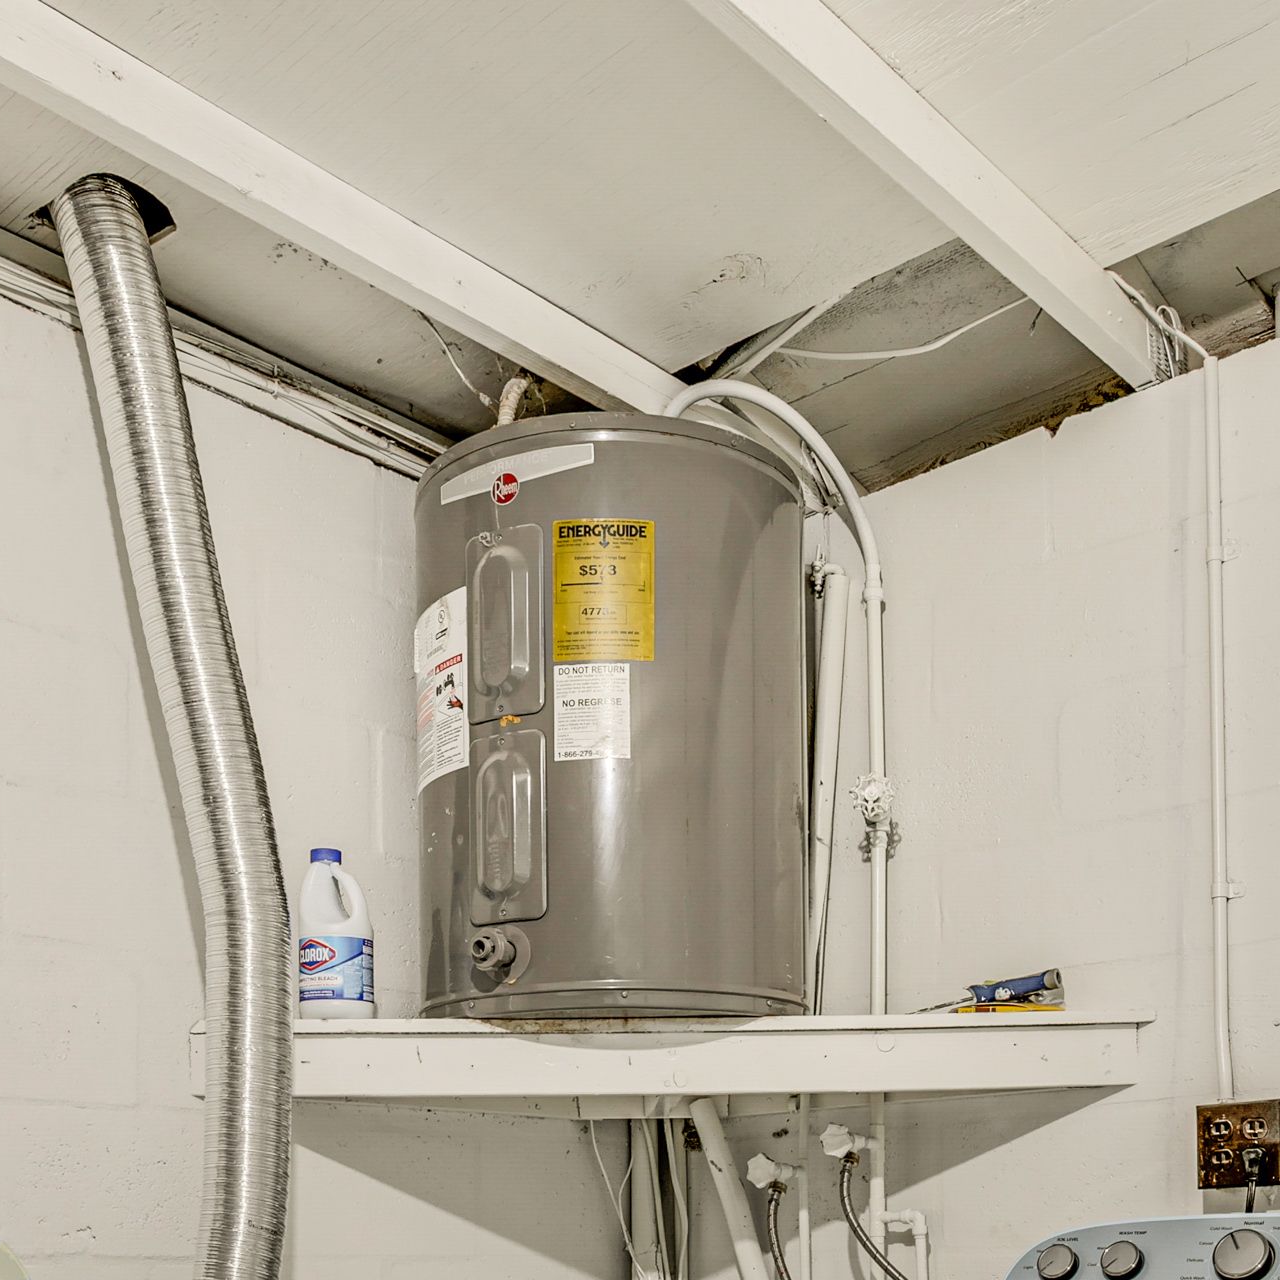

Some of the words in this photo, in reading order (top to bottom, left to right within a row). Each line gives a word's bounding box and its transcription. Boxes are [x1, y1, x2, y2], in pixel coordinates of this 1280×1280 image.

[495, 474, 517, 501] Rheem
[579, 565, 617, 577] $573
[558, 667, 570, 676] DO
[572, 666, 589, 674] NOT
[591, 665, 625, 674] RETURN
[562, 699, 576, 708] NO
[578, 697, 622, 707] REGRESE
